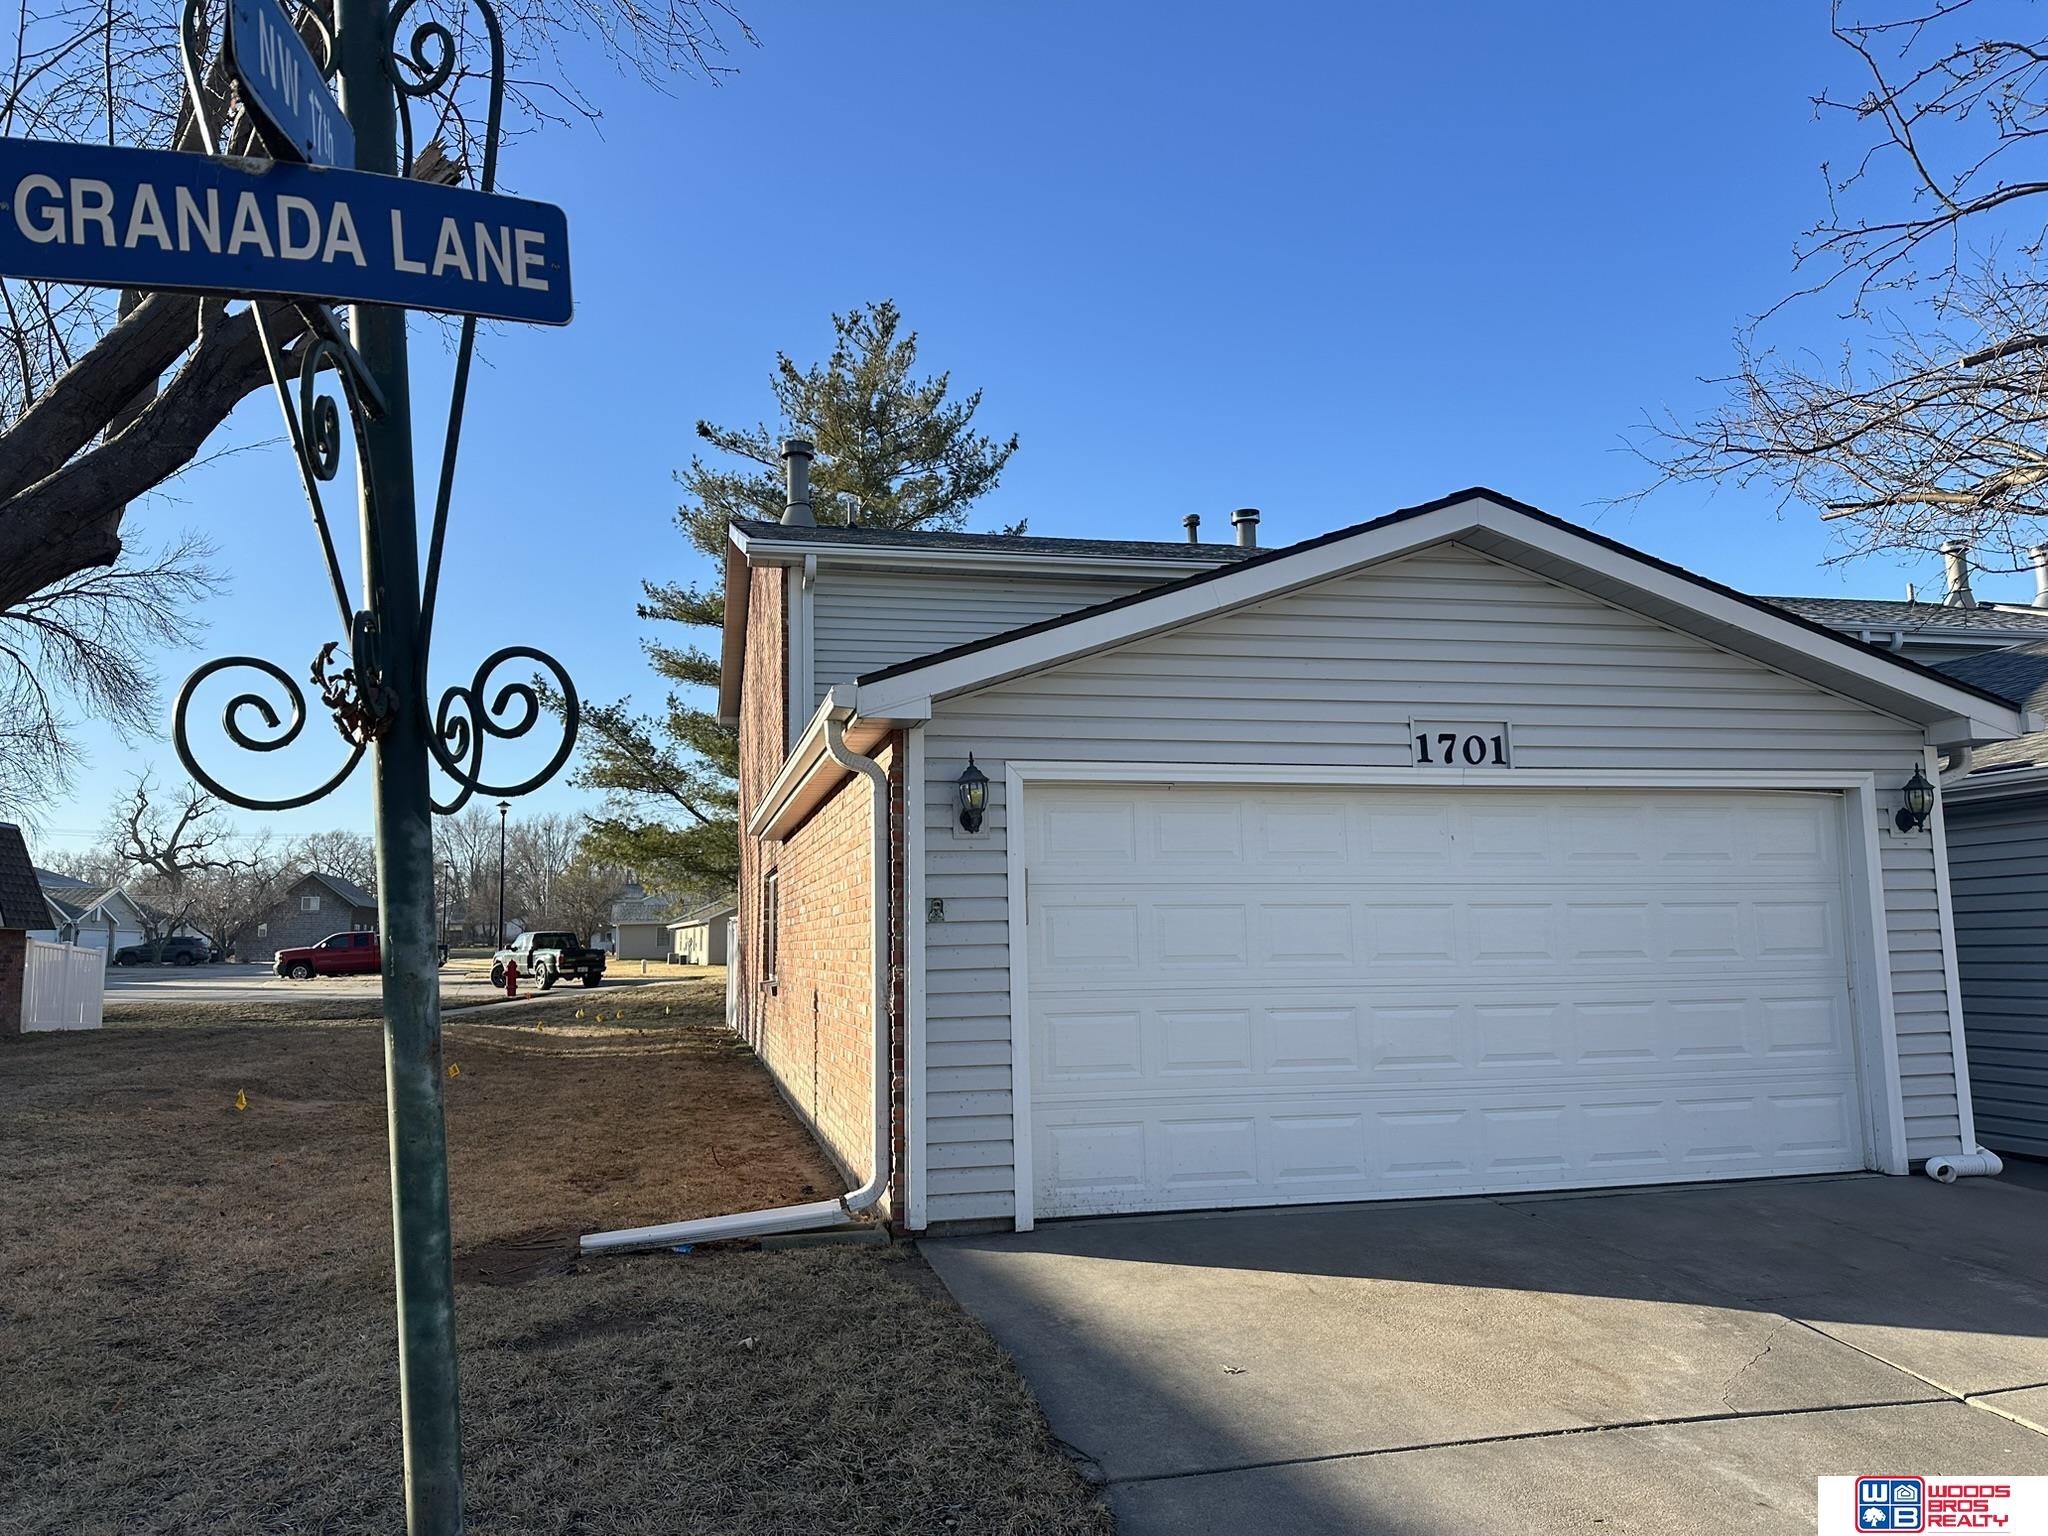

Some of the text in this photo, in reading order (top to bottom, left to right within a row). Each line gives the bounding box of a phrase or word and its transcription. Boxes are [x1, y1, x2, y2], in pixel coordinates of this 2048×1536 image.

[258, 7, 335, 165] NW 17th
[14, 174, 550, 291] GRANADA LANE
[1415, 733, 1507, 765] 1701
